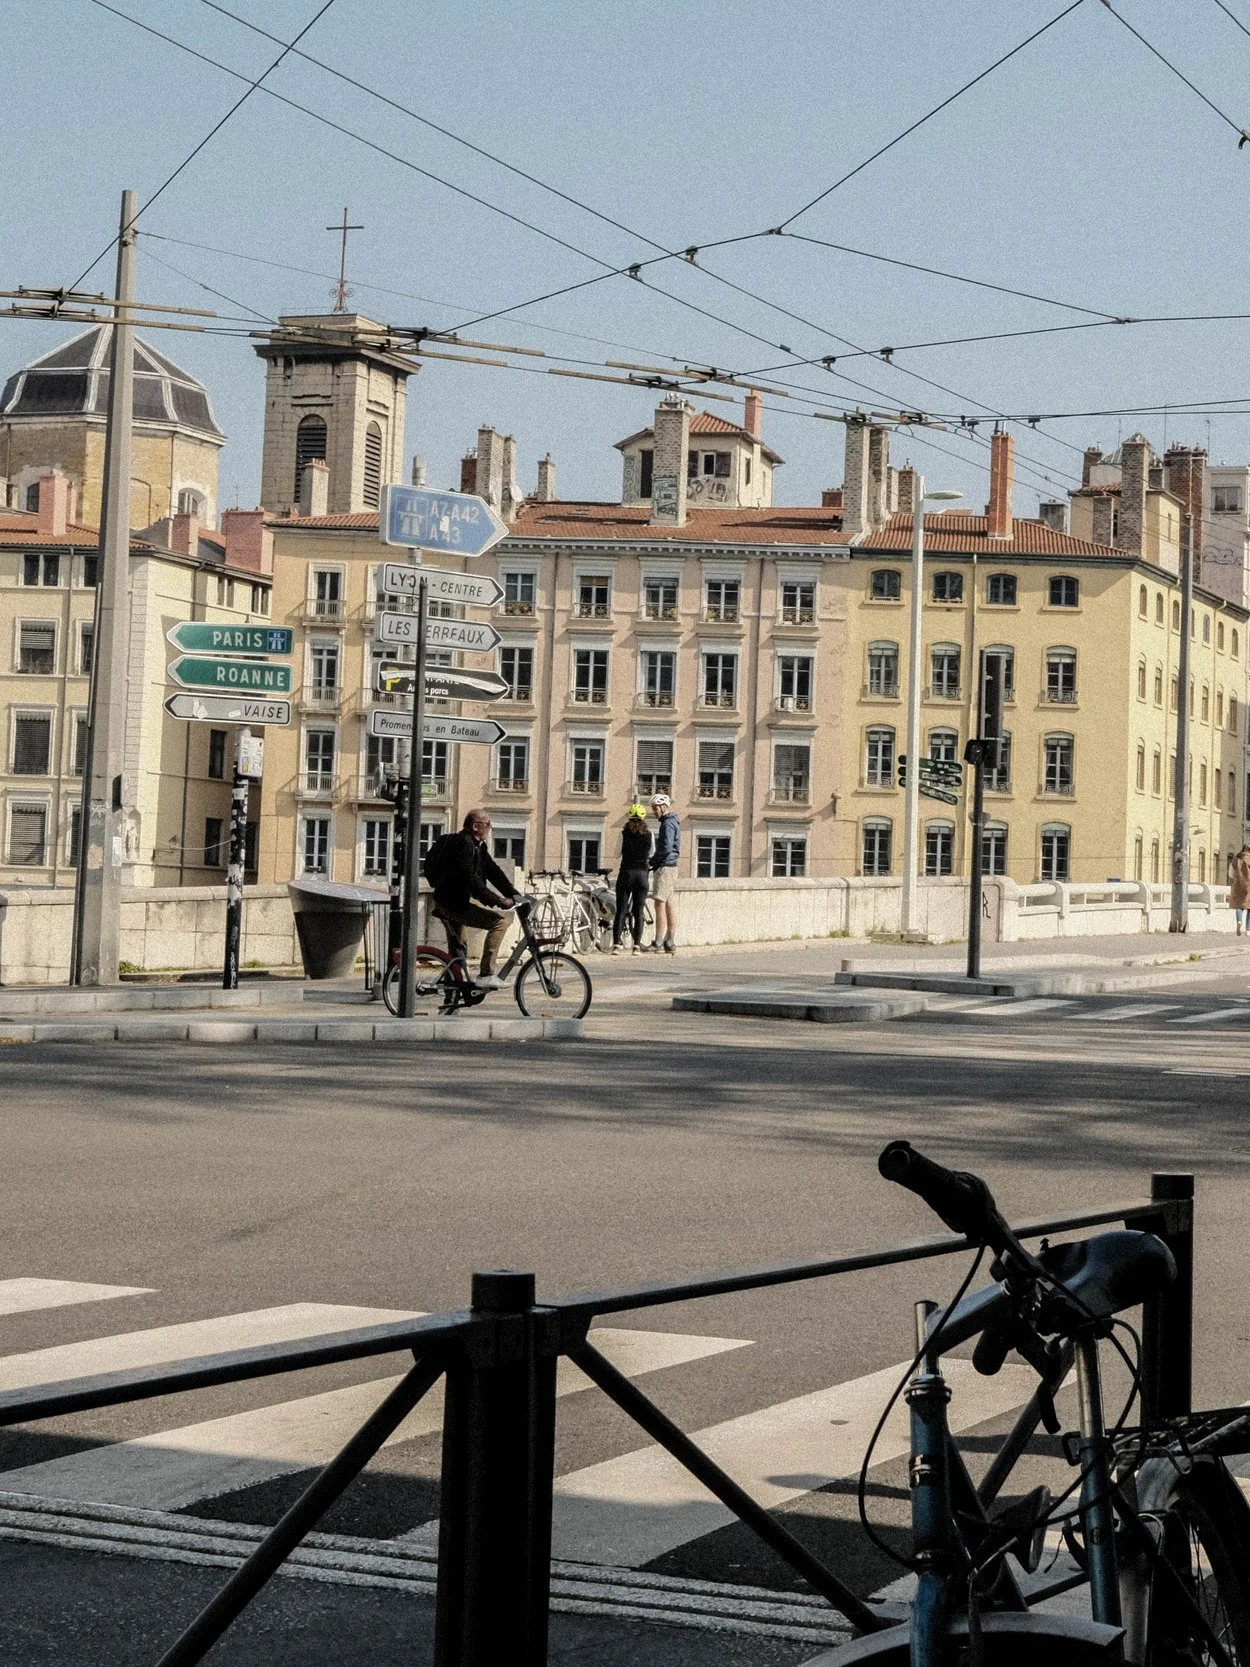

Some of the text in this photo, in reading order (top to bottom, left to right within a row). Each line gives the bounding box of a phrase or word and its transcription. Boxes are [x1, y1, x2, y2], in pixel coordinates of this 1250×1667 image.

[440, 581, 483, 598] CENTRE
[212, 631, 263, 648] PARIS
[388, 620, 485, 645] LES ERREAUX
[216, 666, 285, 687] ROANNE
[430, 687, 450, 696] parcs
[244, 705, 283, 719] VAISE
[435, 725, 446, 733] en
[450, 725, 480, 737] Bateau
